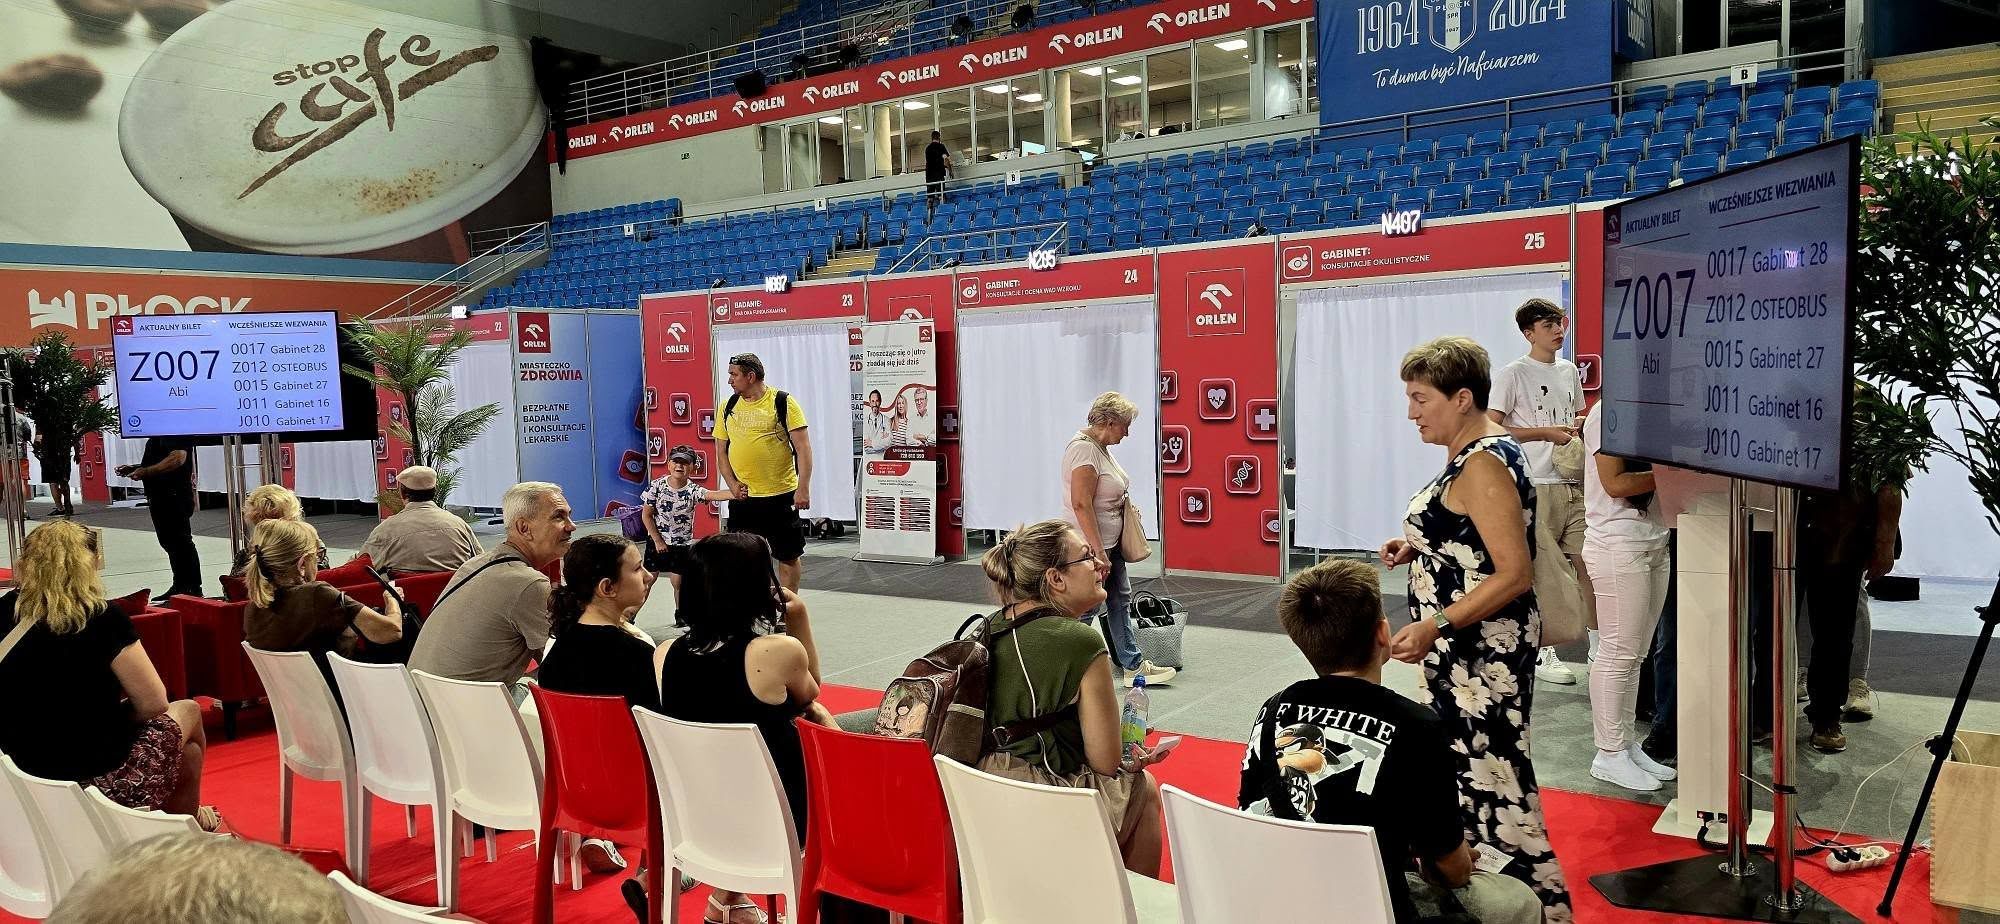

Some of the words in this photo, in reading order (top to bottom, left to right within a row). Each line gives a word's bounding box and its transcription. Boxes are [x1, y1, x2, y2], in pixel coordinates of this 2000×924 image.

[1175, 2, 1230, 27] ORLEN
[1357, 0, 1419, 54] 1964
[1074, 25, 1123, 48] ORLEN
[982, 46, 1028, 67] ORLEN
[272, 54, 361, 86] stop
[898, 64, 940, 84] ORLEN
[1372, 68, 1387, 88] To
[1389, 69, 1428, 86] duma
[1430, 62, 1456, 85] być
[1456, 49, 1541, 81] Nafciarzem
[1741, 69, 1748, 81] B
[822, 80, 859, 99] ORLEN
[750, 95, 785, 113] ORLEN
[685, 110, 718, 126] ORLEN
[624, 122, 654, 138] ORLEN
[569, 134, 597, 149] ORLEN
[1708, 186, 1773, 215] WCZEŚNIEJSZE
[1775, 170, 1836, 198] WEZWANIA
[1625, 213, 1660, 235] AKTUALNY
[1661, 209, 1681, 227] BILET
[1524, 232, 1545, 250] 25
[1321, 247, 1371, 260] GABINET:
[1707, 246, 1748, 279] 0017
[1753, 246, 1805, 273] Gabit
[1809, 241, 1828, 265] 28
[1321, 259, 1372, 271] KONSULTACJE
[1373, 253, 1431, 266] OKULISTYCZNE
[1124, 269, 1138, 284] 24
[985, 279, 1020, 290] GABINET:
[842, 294, 853, 306] 23
[1612, 268, 1696, 341] Z007
[1705, 293, 1745, 323] Z012
[1750, 293, 1828, 321] OSTEOBUS
[228, 320, 284, 329] WCZEŚNIEJSZE
[285, 320, 328, 328] WEZWANIA
[494, 321, 502, 332] 22
[1195, 313, 1237, 325] ORLEN
[139, 323, 180, 332] AKTUALNY
[181, 323, 202, 331] BILET
[231, 343, 265, 355] 0017
[271, 345, 311, 355] Gabinet
[313, 344, 326, 353] 28
[523, 340, 547, 348] ORLEN
[665, 344, 690, 354] ORLEN
[911, 348, 926, 357] jutro
[1704, 339, 1743, 369] 0015
[1749, 347, 1802, 370] Gabinet
[1806, 346, 1825, 369] 27
[128, 350, 220, 382] Z007
[232, 361, 268, 374] Z012
[272, 362, 328, 373] OSTEOBUS
[519, 362, 571, 370] MIASTECZKO
[1641, 352, 1660, 375] Abi
[520, 369, 583, 381] ZDROWIA
[168, 386, 188, 397] Abi
[234, 379, 268, 391] 0015
[273, 381, 314, 391] Gabinet
[316, 380, 328, 390] 27
[236, 397, 268, 411] J011
[275, 399, 315, 409] Gabinet
[318, 399, 330, 408] 16
[522, 403, 570, 413] BEZPŁATNE
[1704, 385, 1739, 414] J011
[1748, 394, 1801, 420] Gabinet
[1805, 398, 1823, 422] 16
[238, 414, 270, 427] J010
[276, 416, 316, 426] Gabinet
[319, 415, 331, 425] 17
[523, 414, 560, 423] BADANIA
[528, 423, 586, 433] KONSULTACJE
[524, 433, 570, 444] LEKARSKIE
[1703, 426, 1740, 458] J010
[1747, 440, 1800, 468] Gabinet
[1804, 447, 1822, 470] 17
[1297, 704, 1396, 745] WHITE
[1291, 776, 1309, 791] TAZ
[1291, 789, 1308, 815] 22
